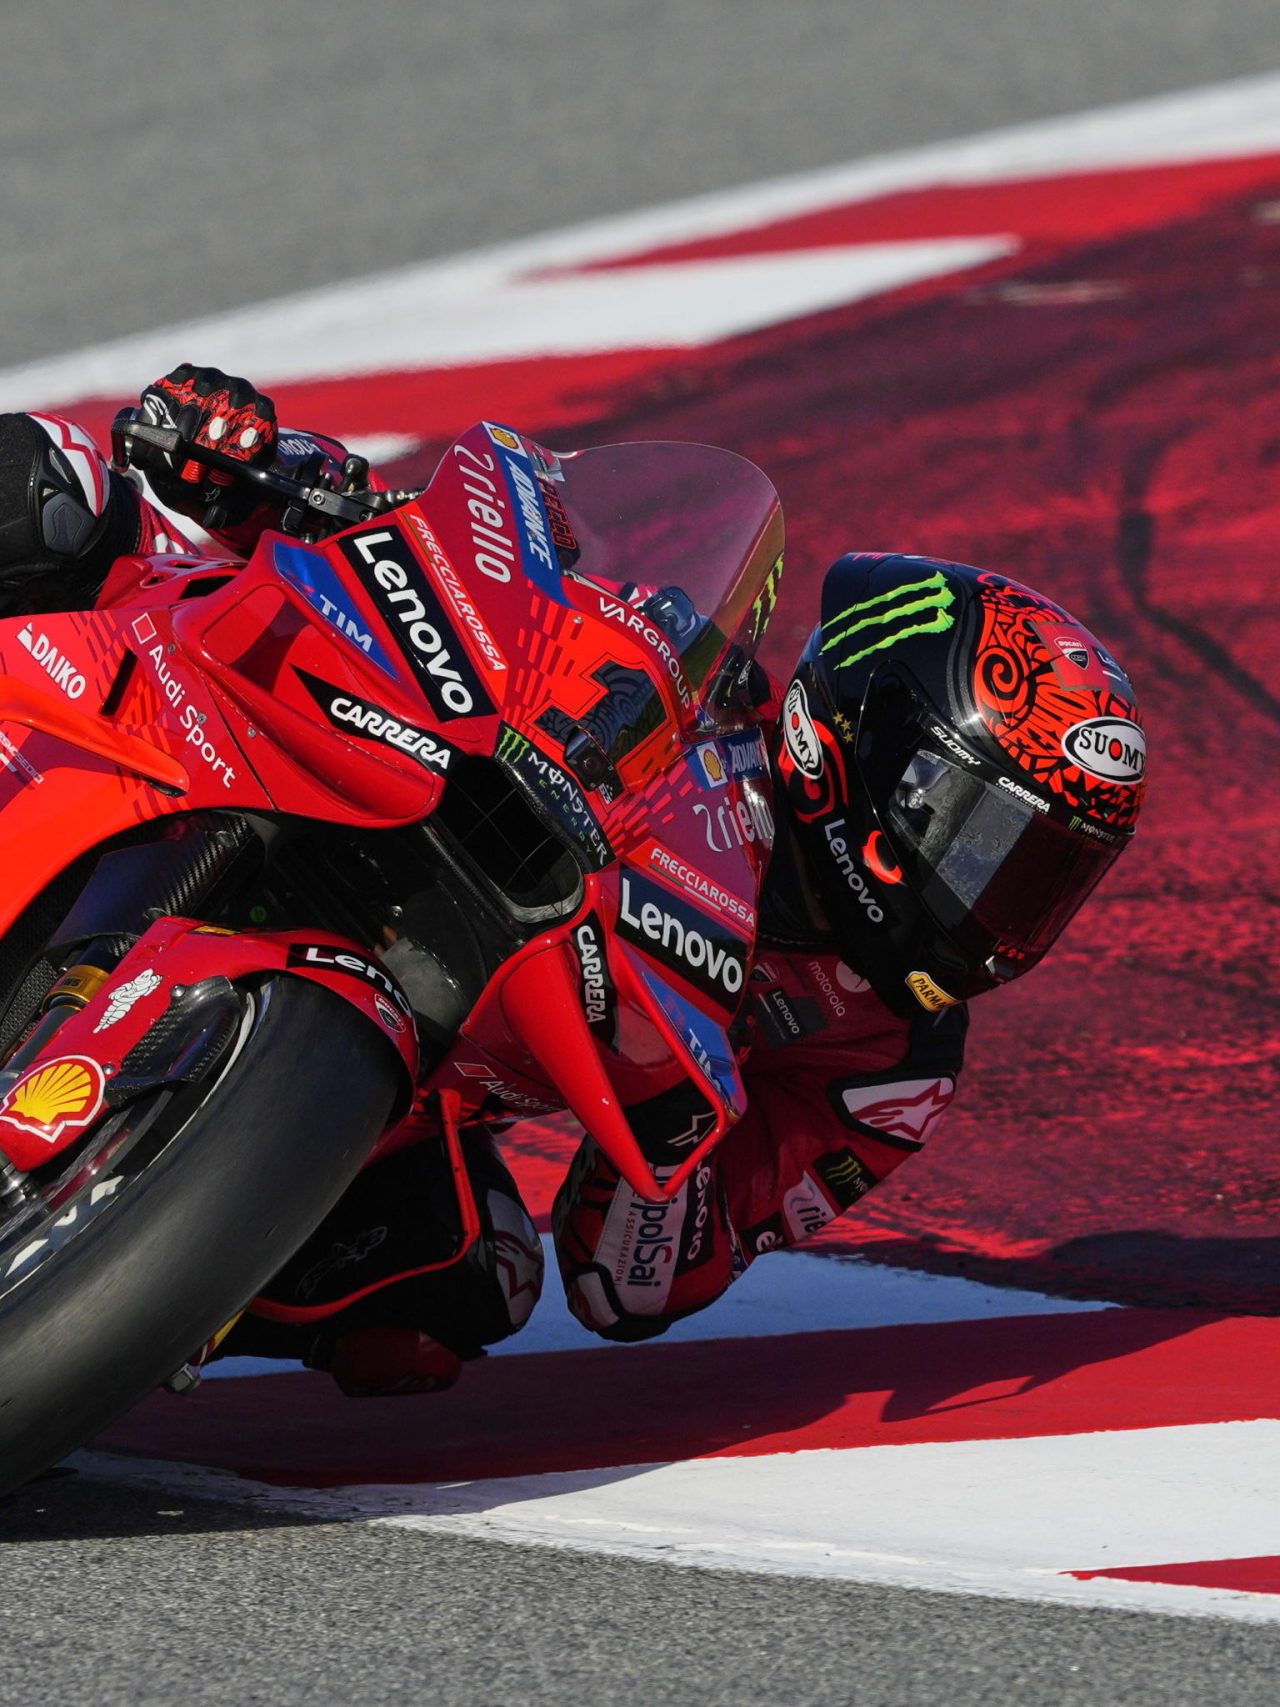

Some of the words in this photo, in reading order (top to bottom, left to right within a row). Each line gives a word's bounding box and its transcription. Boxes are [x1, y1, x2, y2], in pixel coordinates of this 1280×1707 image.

[507, 456, 553, 571] ADVANCE
[320, 594, 373, 652] TIM
[353, 531, 474, 714] Lenovo
[410, 513, 506, 671] FRECCIAROSSA
[32, 634, 86, 700] DAIKO
[149, 648, 186, 704] Audi
[179, 705, 237, 789] Sport
[331, 697, 452, 770] CARRERA
[787, 686, 816, 766] SUOMY
[930, 726, 981, 767] SUOMY
[1079, 727, 1146, 774] SUOMY
[998, 776, 1051, 813] CARRERA
[650, 847, 755, 927] FRECCIAROSSA
[824, 818, 884, 924] Lenovo
[576, 924, 606, 1024] CARRERA
[619, 878, 744, 993] Lenovo
[771, 991, 800, 1034] Lenovo
[808, 961, 846, 1017] motorola
